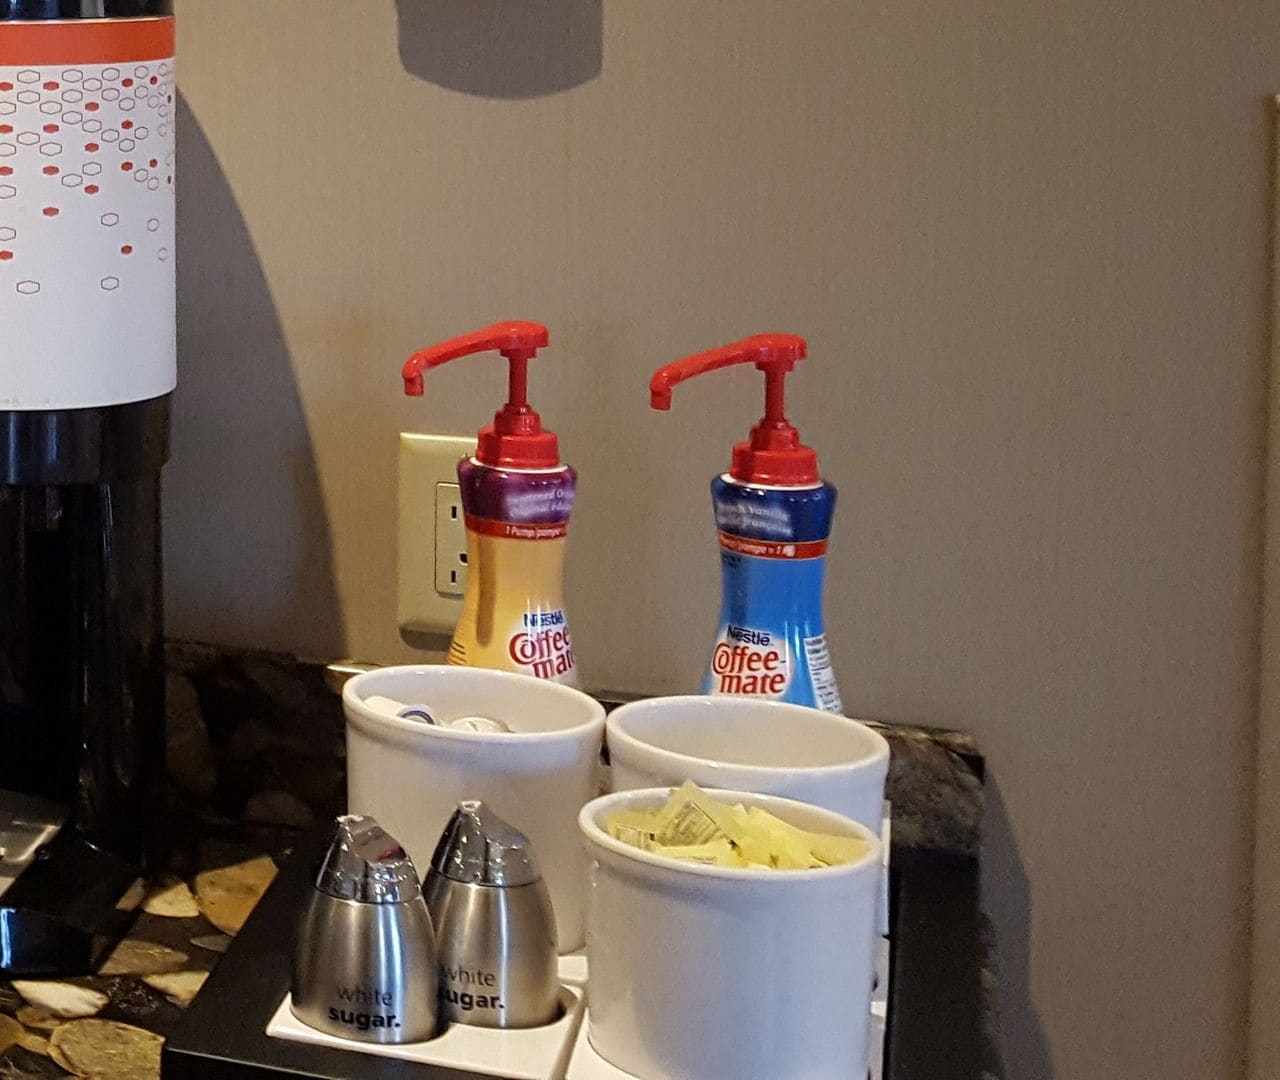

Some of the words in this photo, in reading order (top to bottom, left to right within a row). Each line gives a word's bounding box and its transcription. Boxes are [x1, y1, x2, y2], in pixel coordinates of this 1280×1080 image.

[720, 672, 785, 694] mate
[338, 986, 393, 1007] white
[328, 1006, 401, 1031] sugar.
